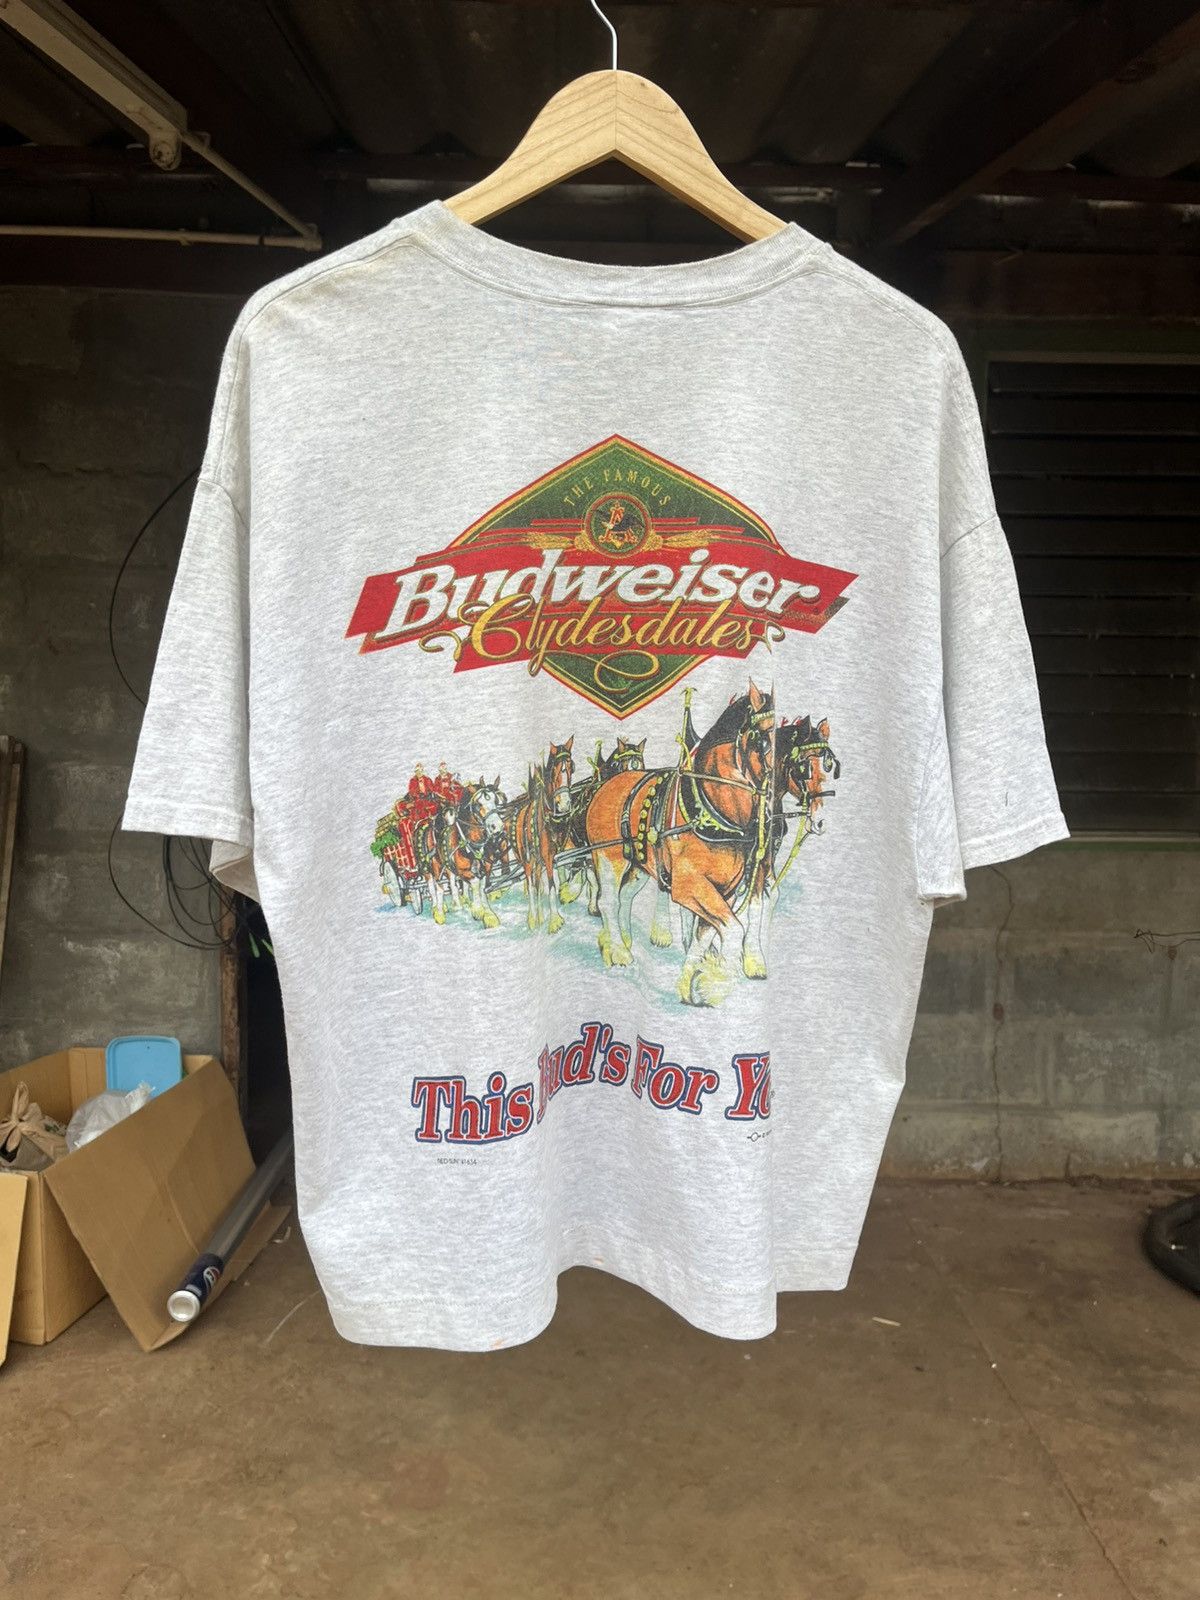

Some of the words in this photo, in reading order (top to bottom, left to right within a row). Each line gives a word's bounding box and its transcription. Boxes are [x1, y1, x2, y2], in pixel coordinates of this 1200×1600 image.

[563, 476, 594, 506] THE
[603, 469, 671, 506] FAMOUS
[374, 548, 821, 641] Budweiser
[419, 594, 785, 677] Clydesdales
[410, 1071, 535, 1145] This
[631, 1034, 720, 1116] For
